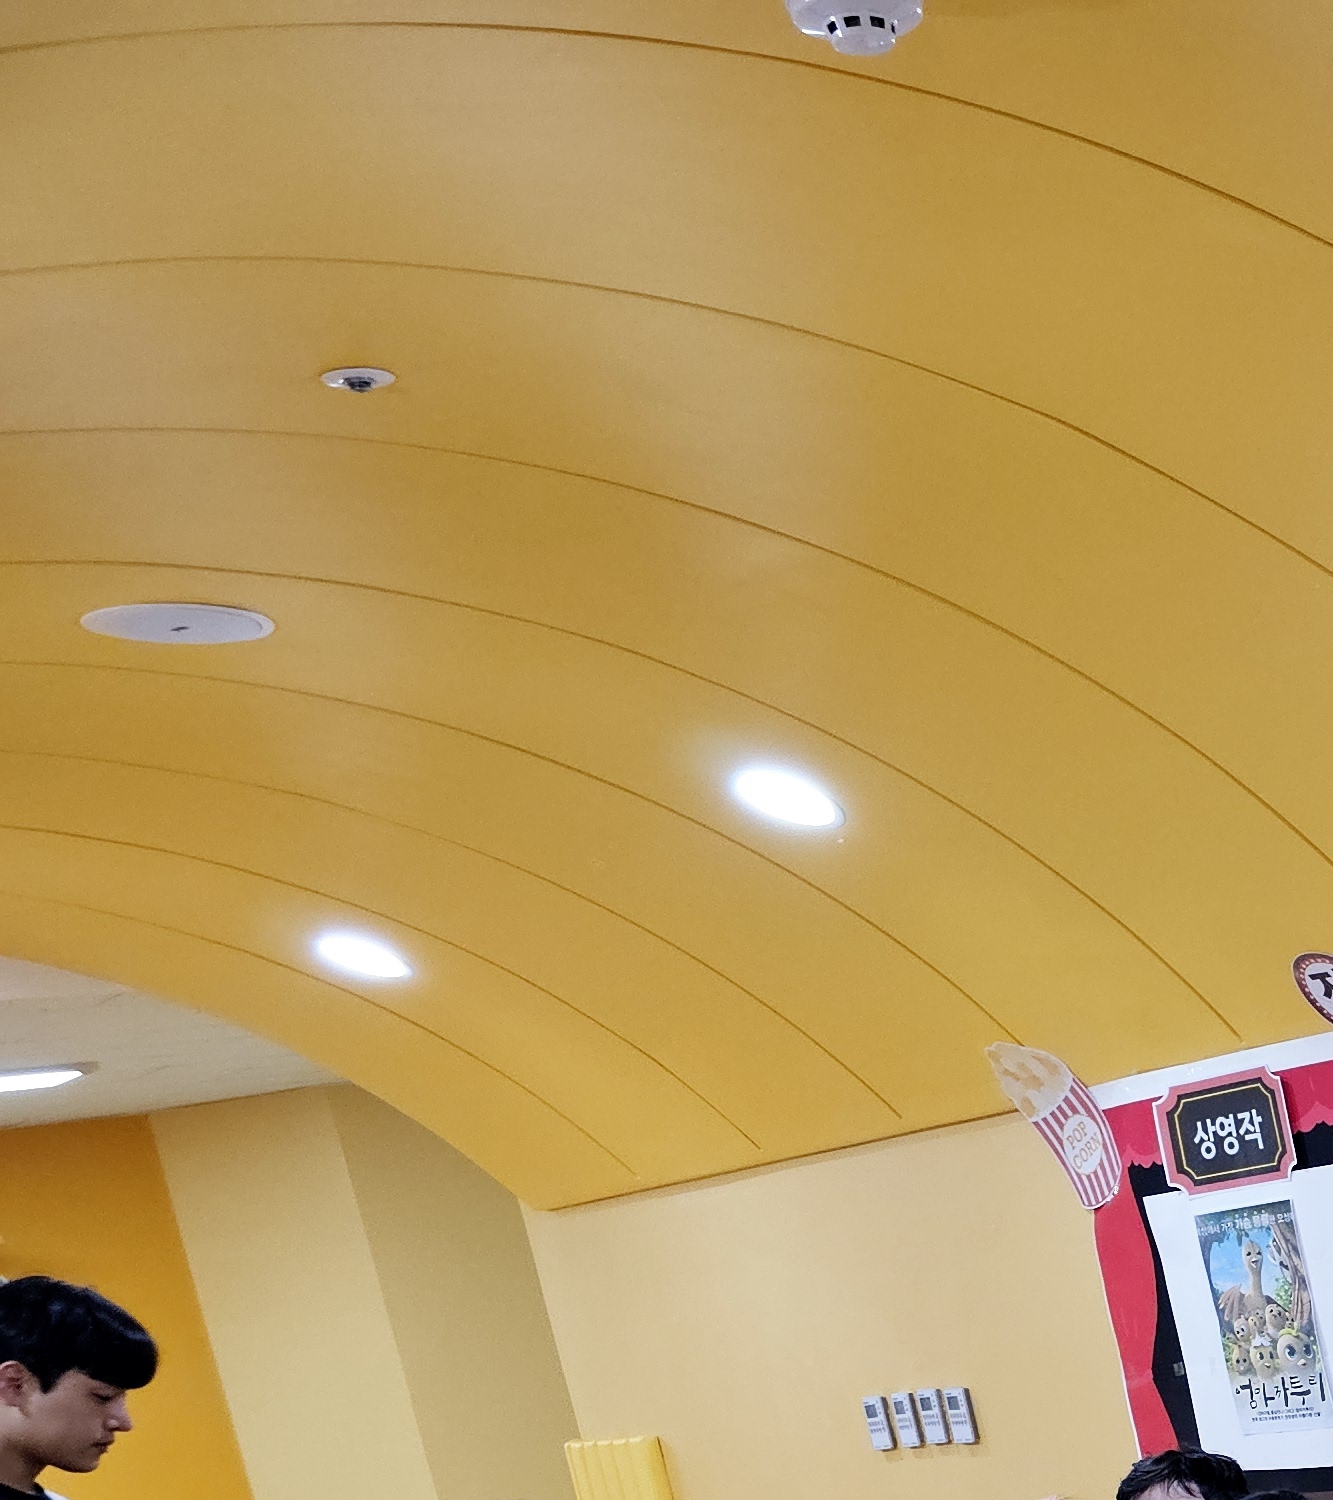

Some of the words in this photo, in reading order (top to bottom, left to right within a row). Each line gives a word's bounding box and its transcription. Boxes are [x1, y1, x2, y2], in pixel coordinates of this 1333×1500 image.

[1066, 1121, 1087, 1151] POP
[1073, 1132, 1101, 1169] CORN
[1193, 1108, 1264, 1161] 상영작
